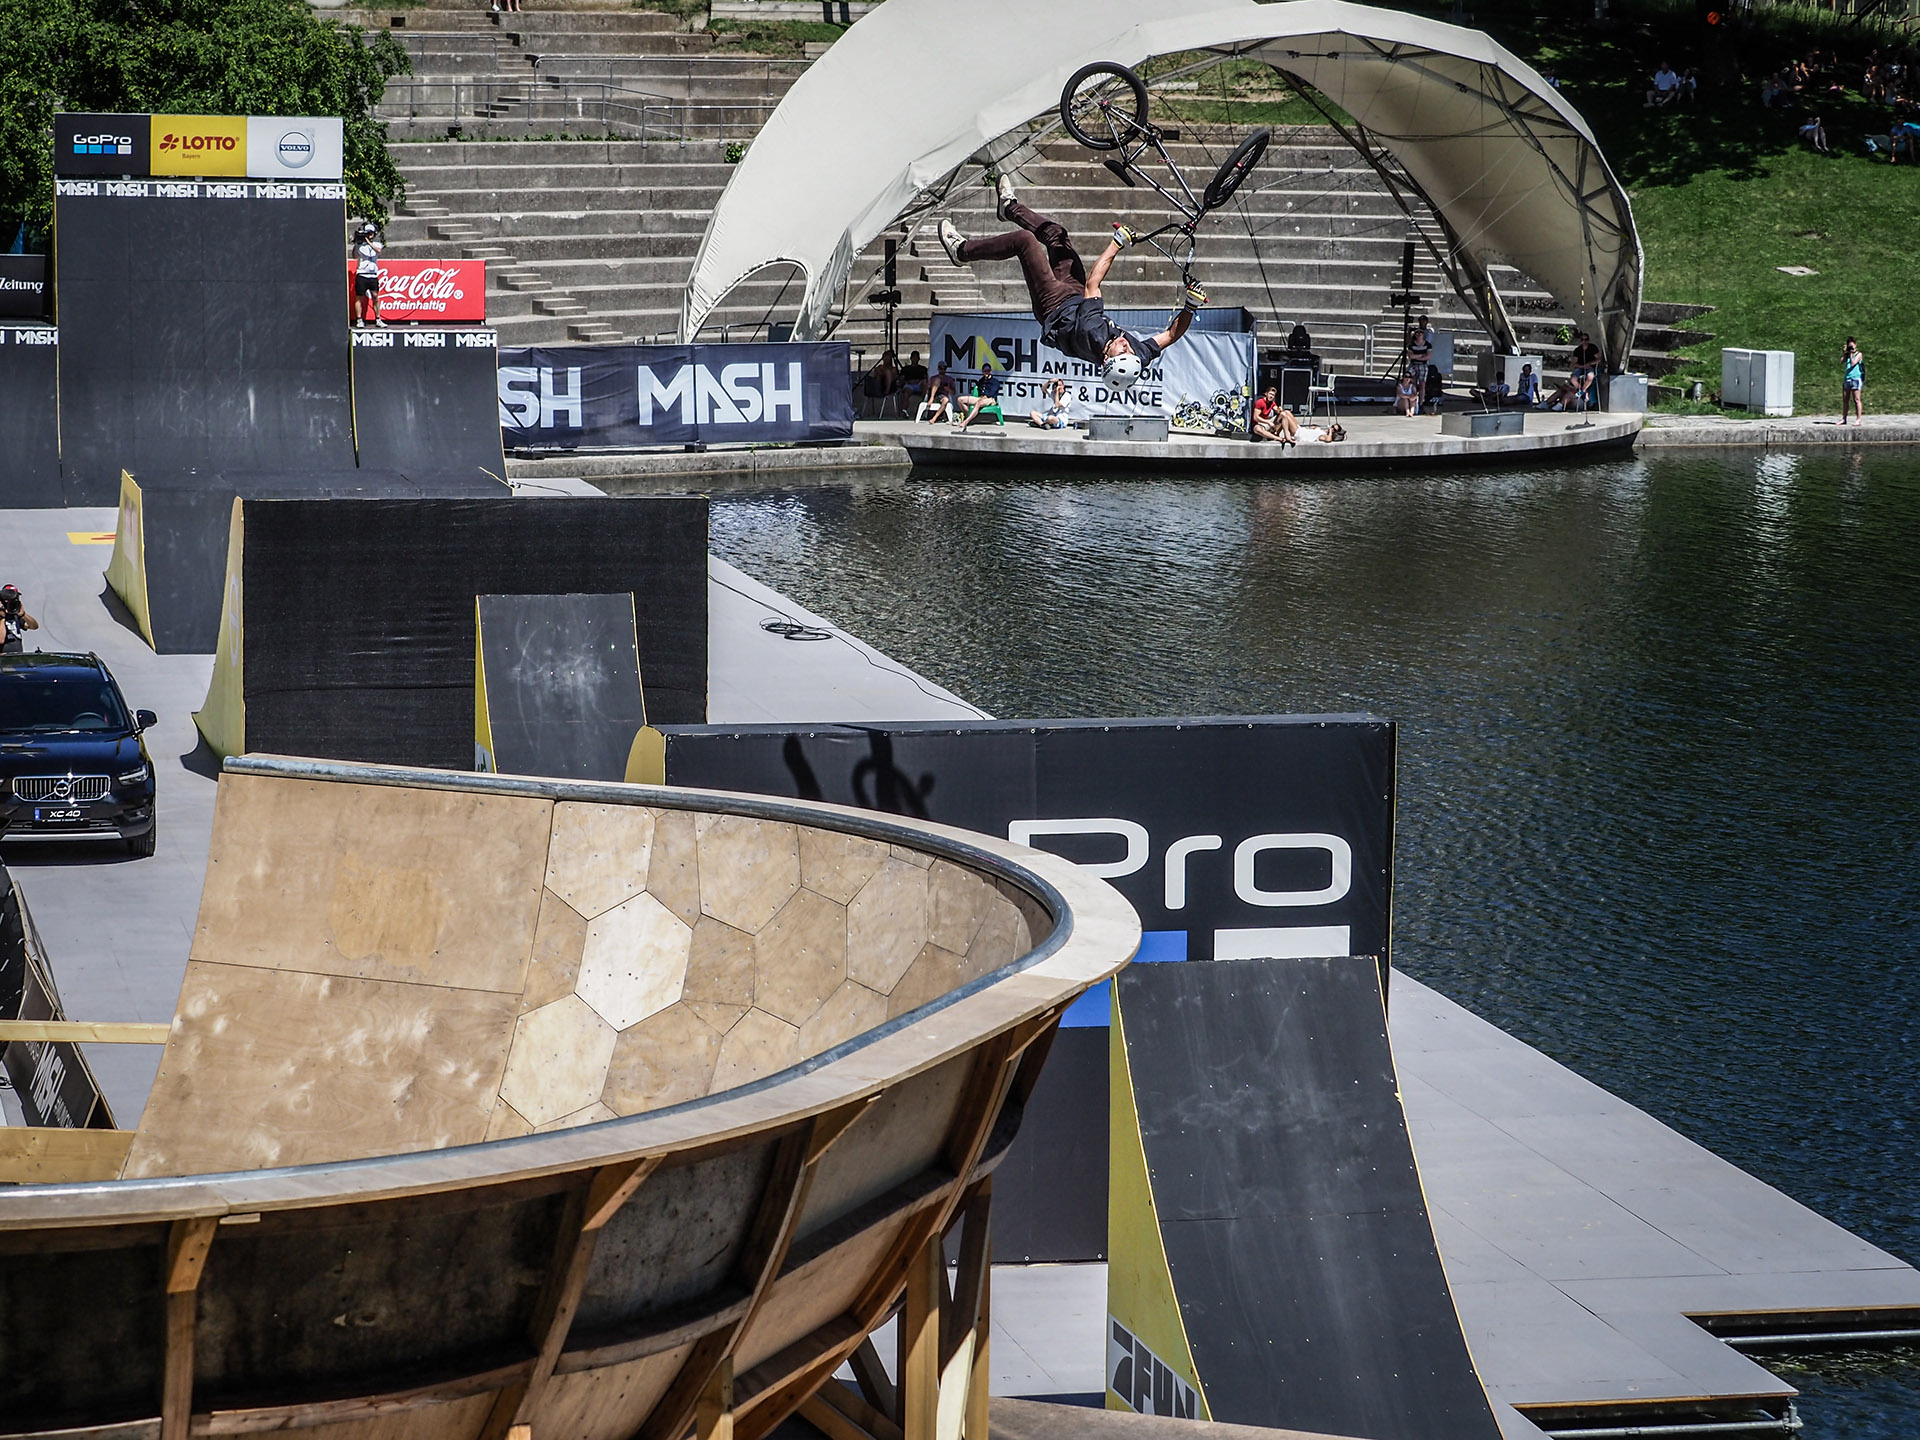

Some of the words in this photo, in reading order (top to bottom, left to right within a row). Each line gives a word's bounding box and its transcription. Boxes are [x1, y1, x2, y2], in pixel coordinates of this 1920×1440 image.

[74, 134, 132, 145] GoPro
[182, 135, 236, 151] LOTTO
[56, 183, 99, 196] MASH
[106, 183, 148, 197] MASH
[156, 183, 198, 197] MASH
[206, 184, 248, 198] MASH
[256, 185, 298, 199] MASH
[306, 186, 346, 200] MASH
[380, 301, 446, 312] koffeinhaltig
[15, 330, 59, 345] MASH
[353, 333, 394, 347] MASH
[404, 333, 446, 347] MASH
[456, 334, 497, 347] MASH
[945, 334, 1038, 373] MASH
[1042, 361, 1067, 375] AM
[638, 362, 804, 426] MASH
[1078, 386, 1090, 402] &
[1095, 387, 1163, 407] DANCE
